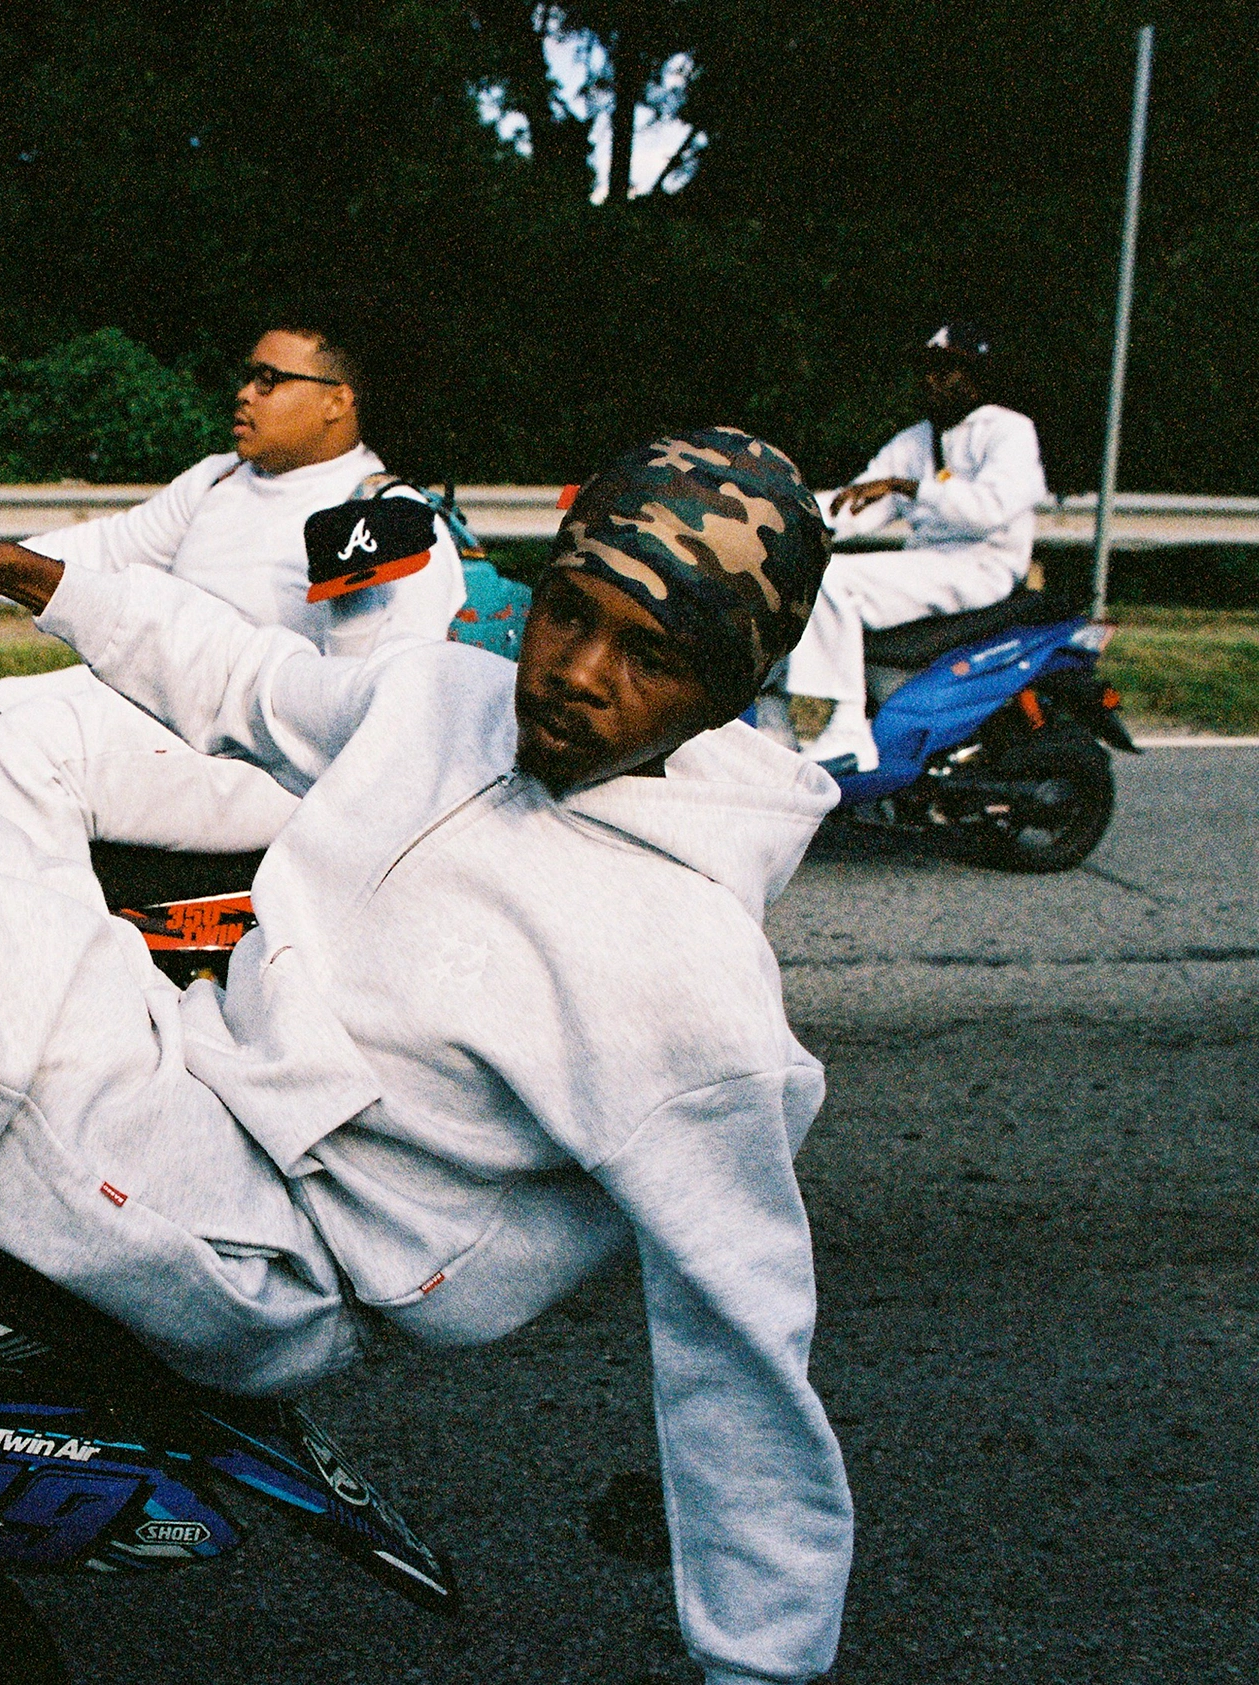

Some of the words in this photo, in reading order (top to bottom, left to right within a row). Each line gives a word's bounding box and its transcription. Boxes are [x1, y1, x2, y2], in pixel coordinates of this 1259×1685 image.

[337, 517, 377, 561] A
[54, 1438, 101, 1462] Air
[145, 1525, 201, 1542] SHOEI
